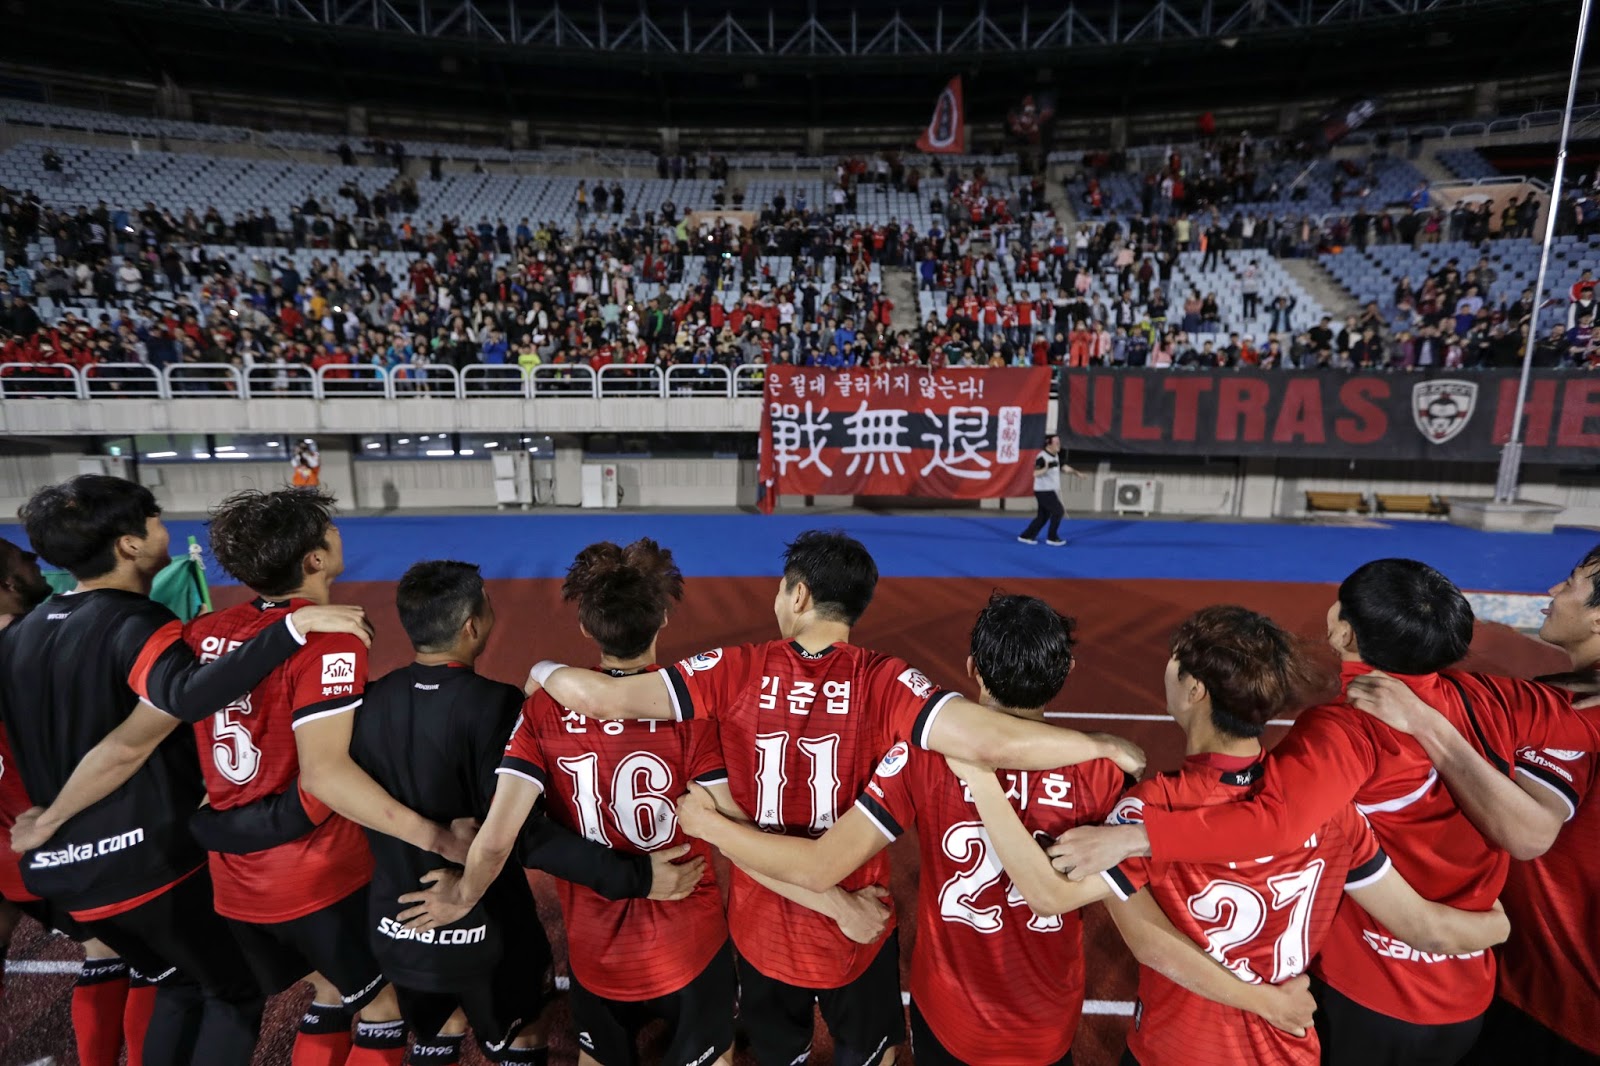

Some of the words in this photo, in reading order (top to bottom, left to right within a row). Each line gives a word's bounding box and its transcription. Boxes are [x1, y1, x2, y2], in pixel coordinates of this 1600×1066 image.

[790, 373, 826, 398] 절대
[834, 372, 910, 397] 물러서지
[918, 376, 984, 399] 않는다!
[1068, 374, 1391, 444] ULTRAS
[322, 685, 353, 696] 부천시
[758, 675, 849, 715] 김준엽
[212, 690, 262, 785] 5
[556, 751, 678, 851] 16
[755, 731, 841, 835] 11
[1187, 858, 1325, 985] 27
